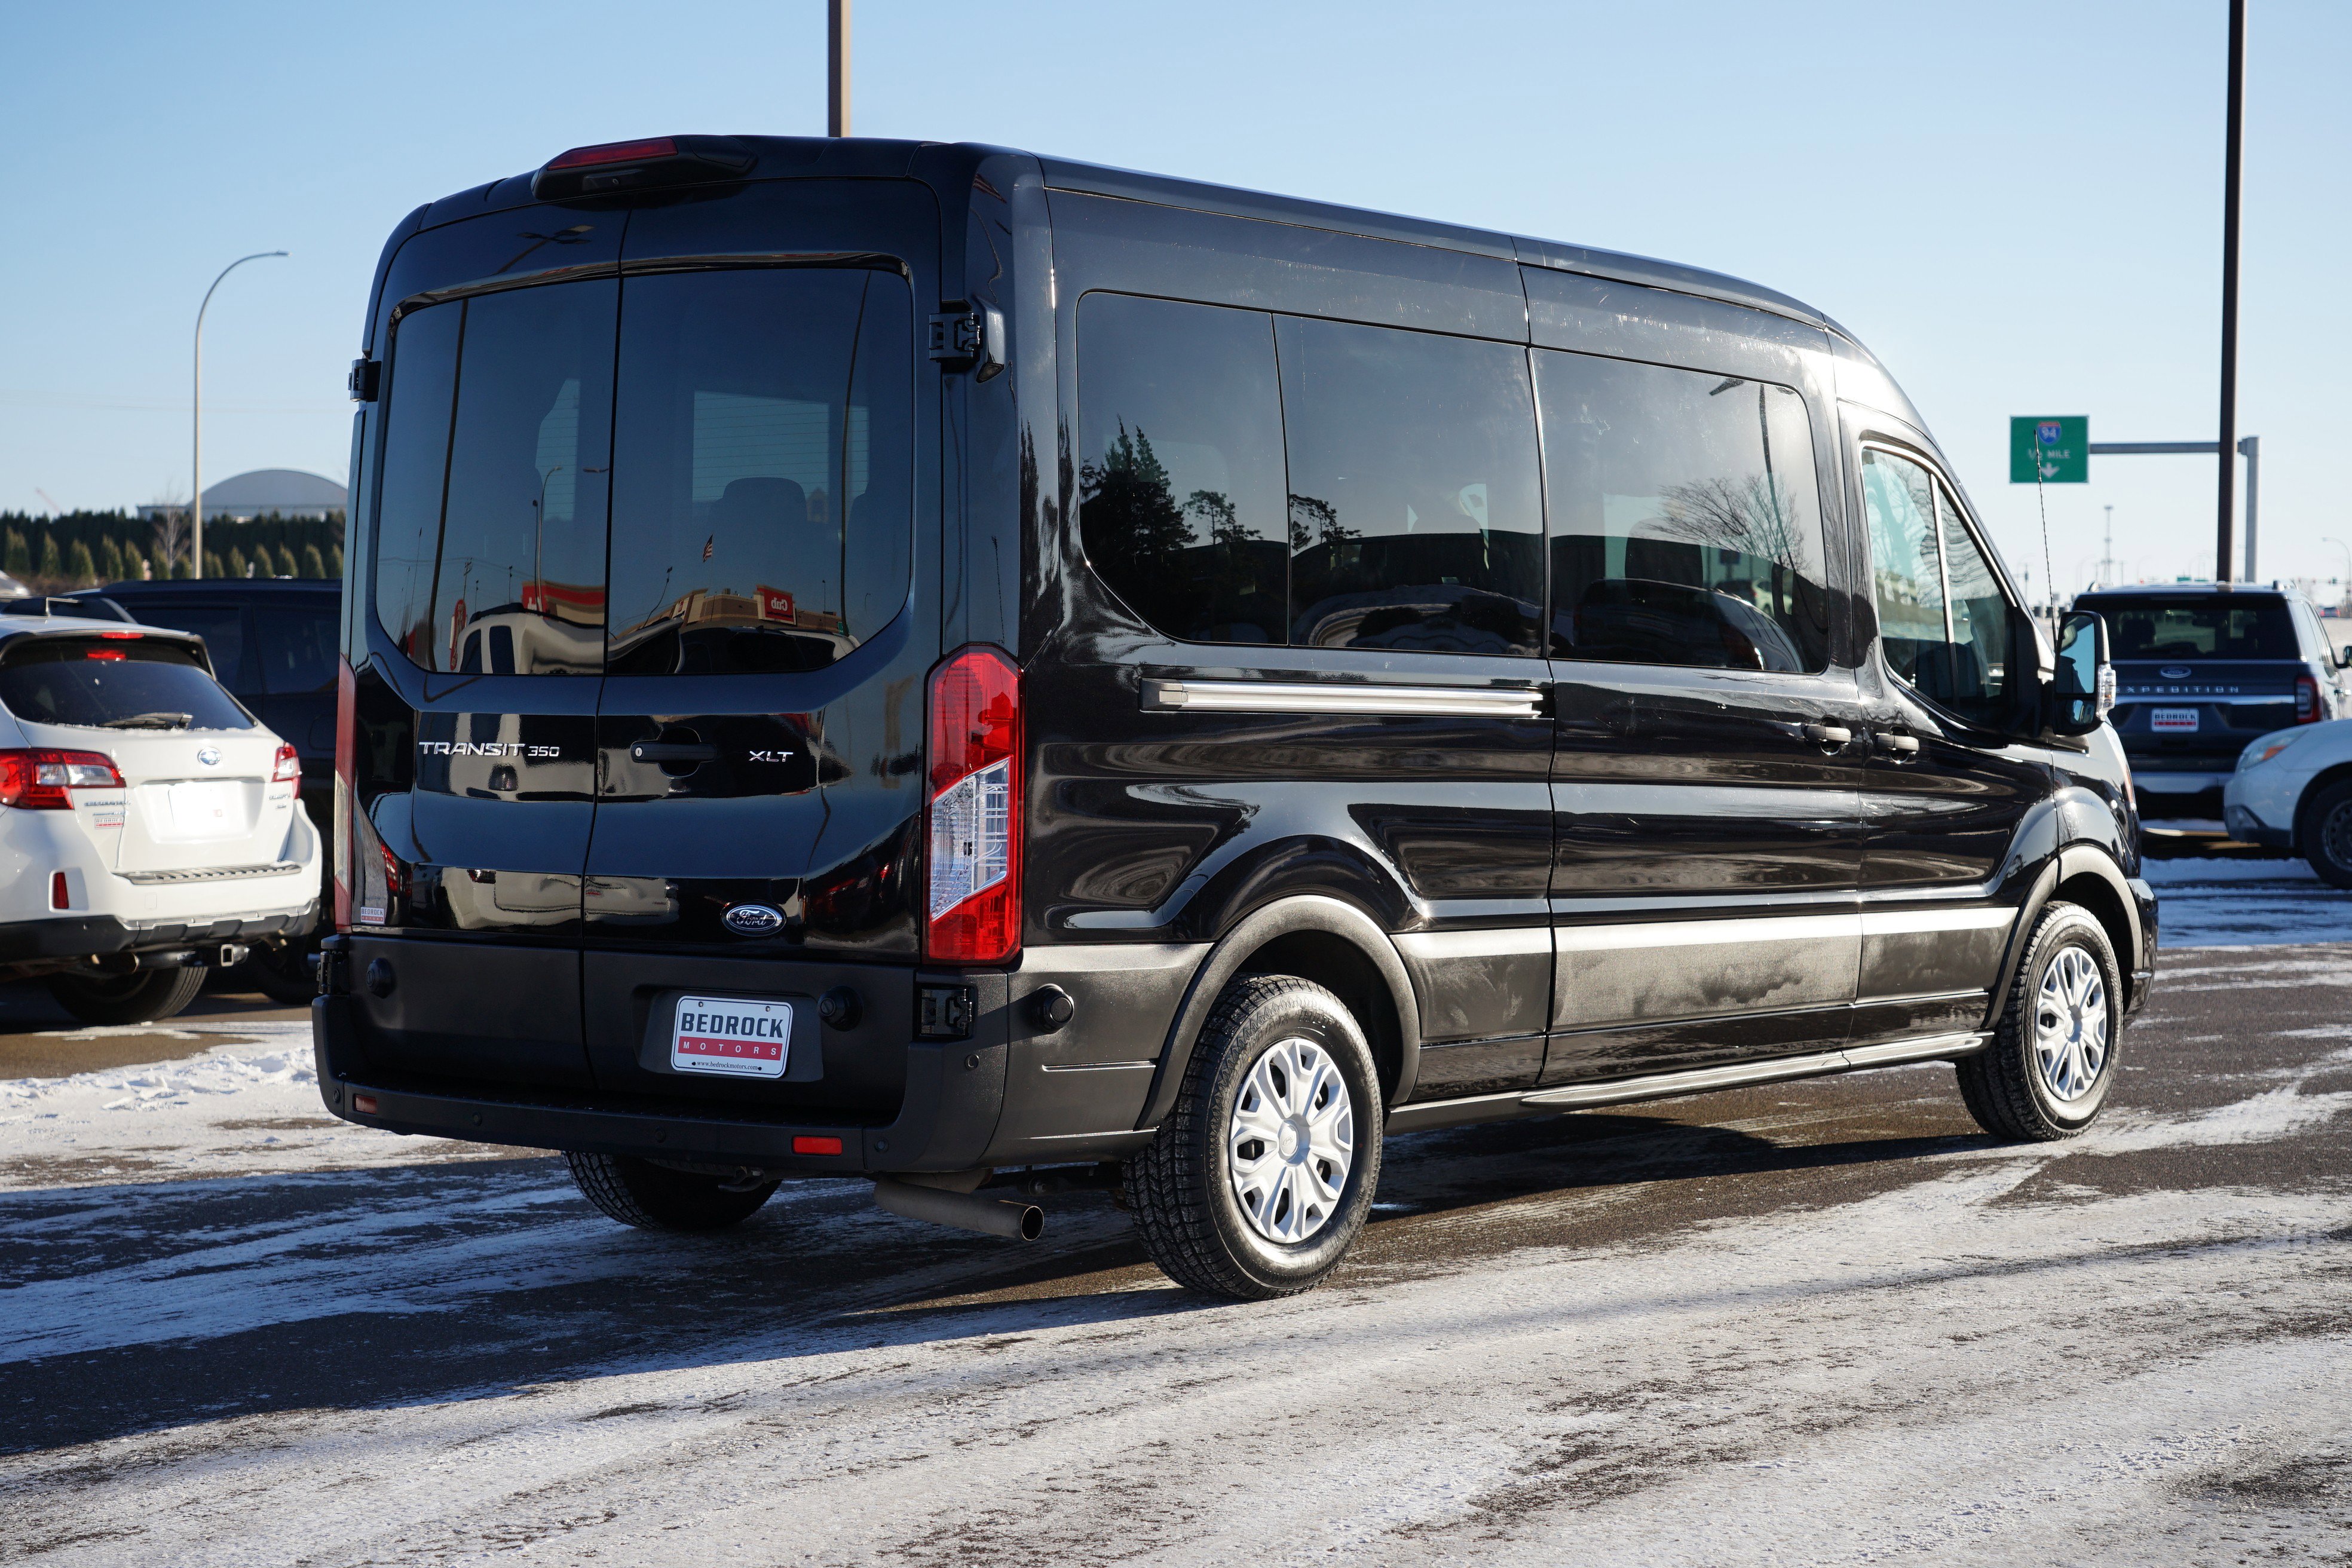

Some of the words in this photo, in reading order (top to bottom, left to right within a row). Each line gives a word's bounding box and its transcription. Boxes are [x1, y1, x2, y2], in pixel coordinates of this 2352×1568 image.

[2042, 427, 2057, 439] 94
[2047, 449, 2070, 459] MILE
[419, 742, 525, 757] TRANSIT
[528, 746, 560, 757] 350
[748, 751, 794, 762] XLT
[736, 909, 767, 926] Ford
[681, 1012, 784, 1038] BEDROCK
[683, 1041, 776, 1055] MOTORS
[697, 1061, 758, 1071] www.bedrockmotors.com
